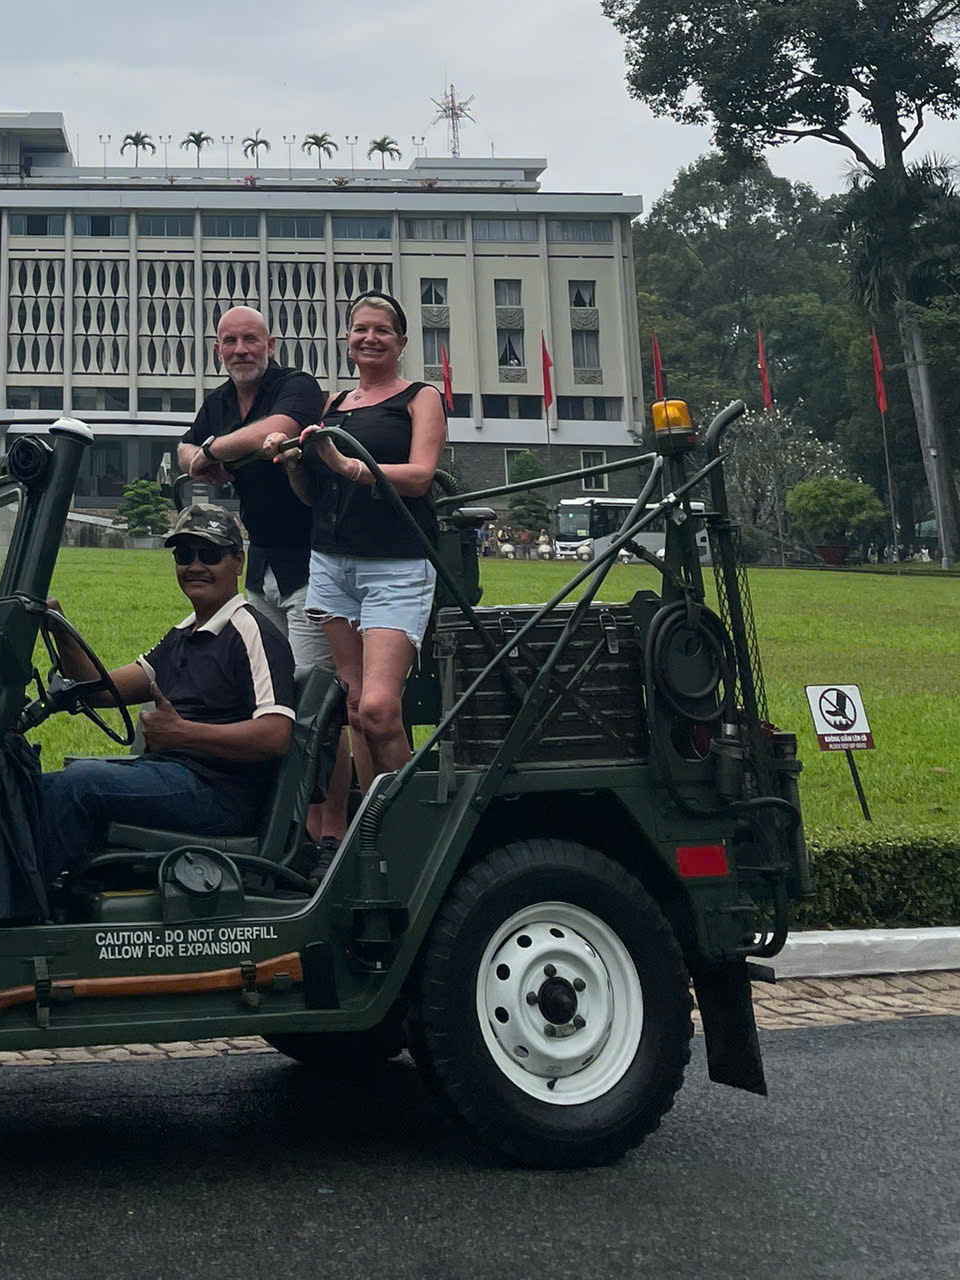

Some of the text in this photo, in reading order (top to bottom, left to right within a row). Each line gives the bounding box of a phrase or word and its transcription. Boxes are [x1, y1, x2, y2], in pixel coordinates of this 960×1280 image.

[95, 931, 153, 946] CAUTION
[164, 929, 184, 943] DO
[187, 928, 214, 942] NOT
[218, 926, 278, 940] OVERFILL
[99, 941, 251, 960] ALLOW FOR EXPANSION
